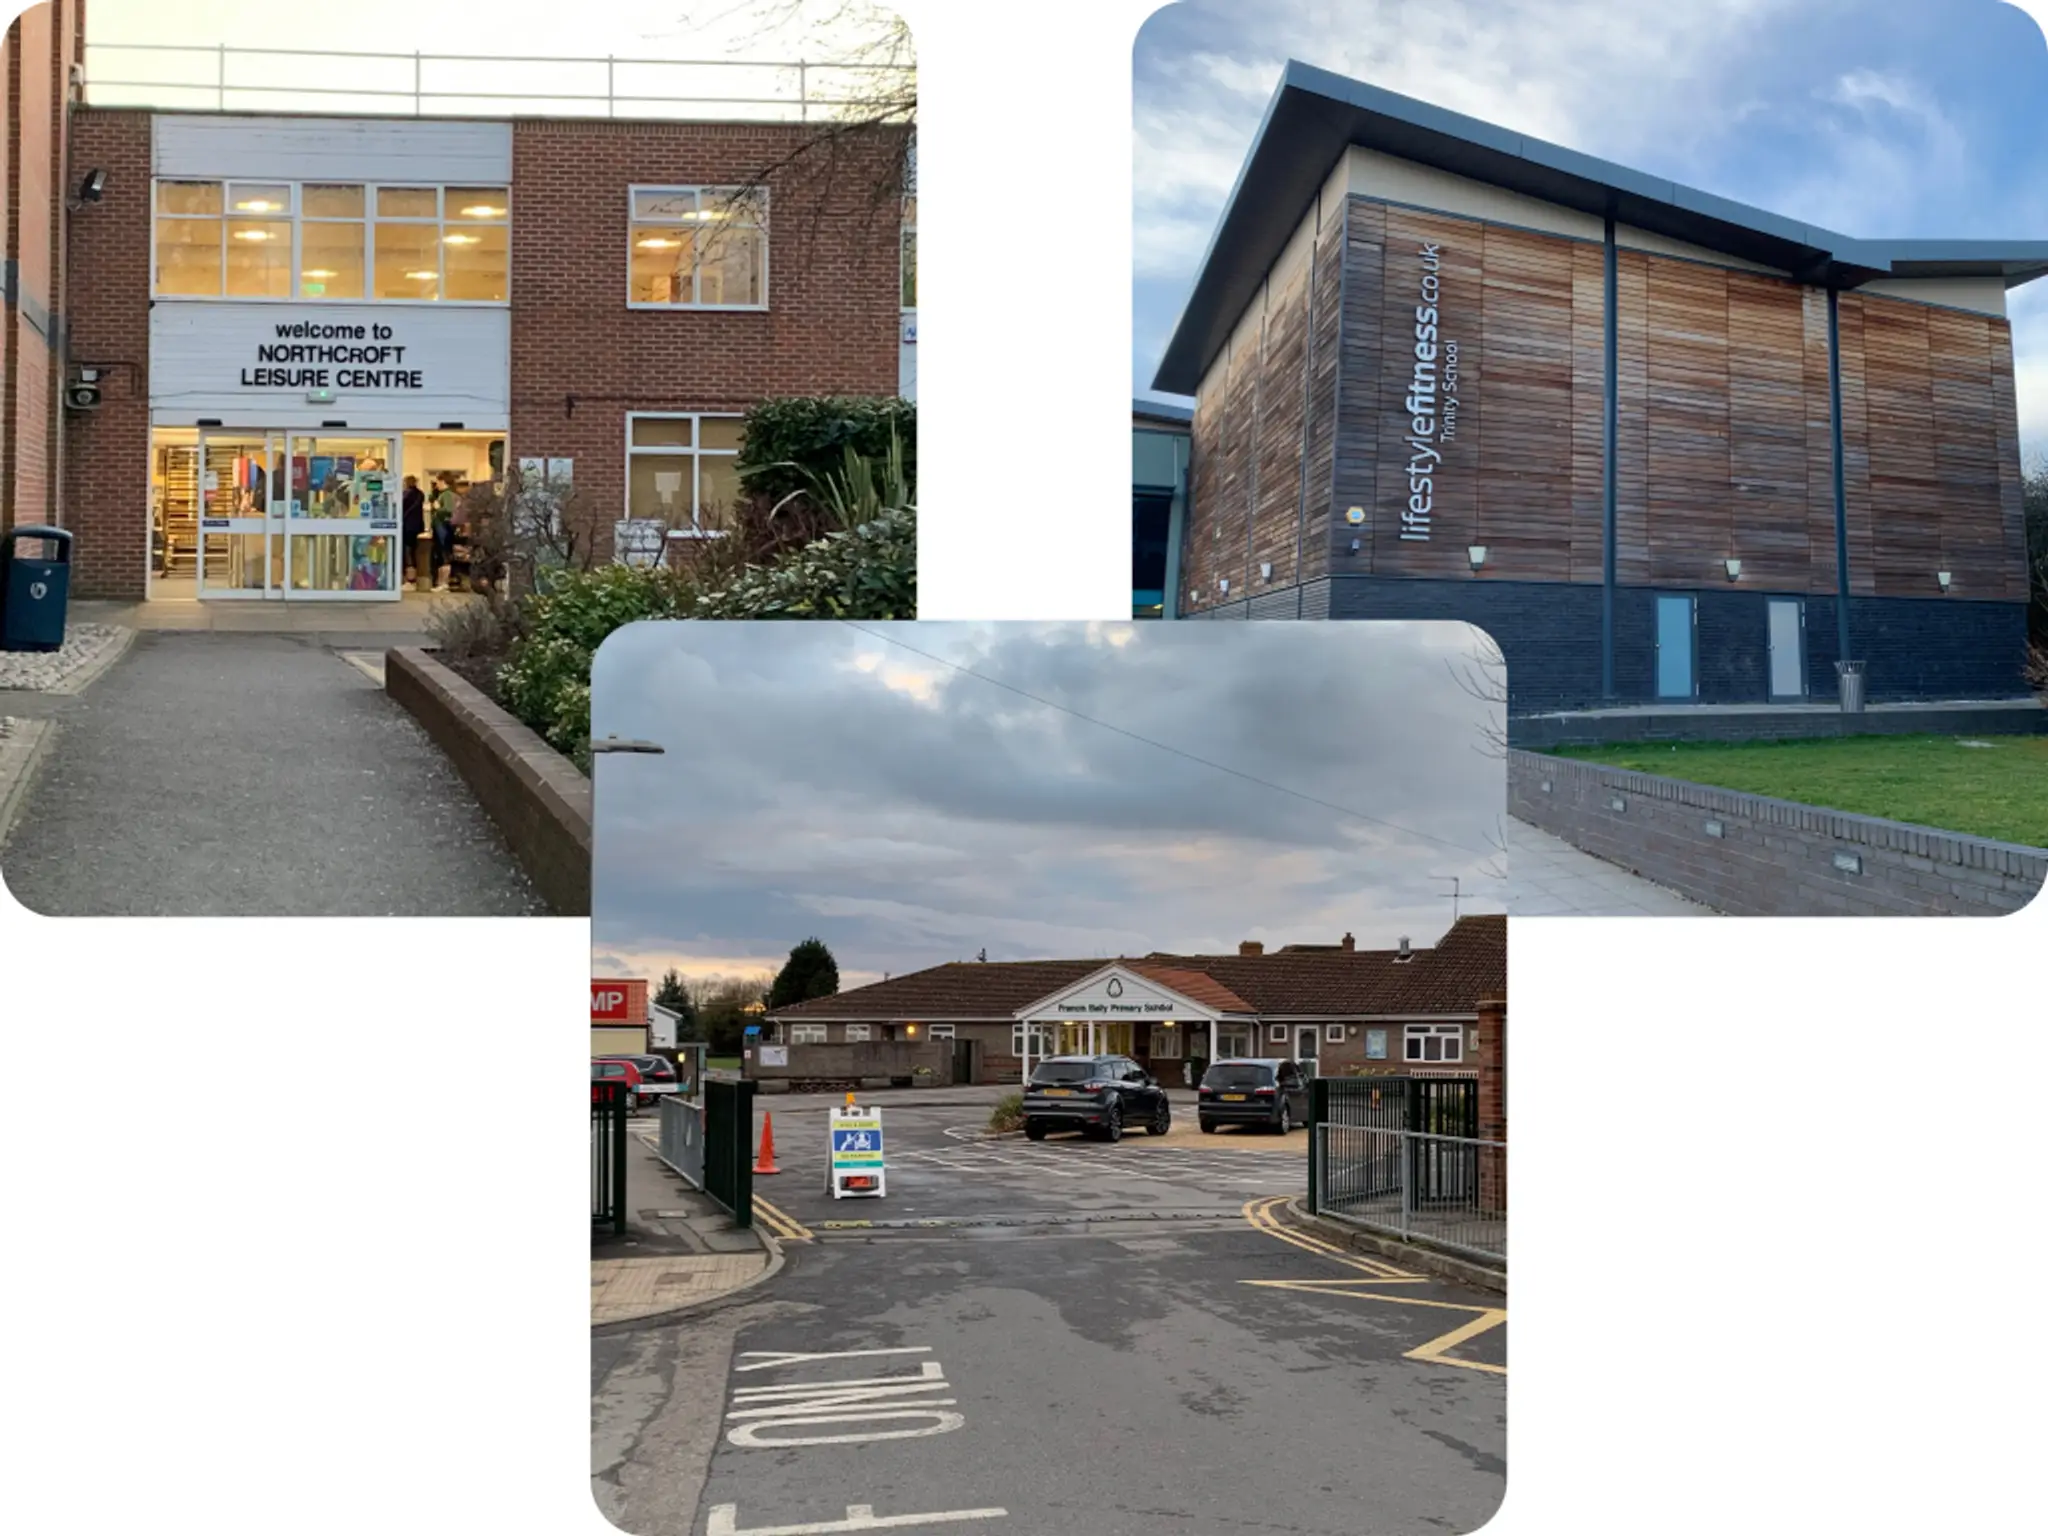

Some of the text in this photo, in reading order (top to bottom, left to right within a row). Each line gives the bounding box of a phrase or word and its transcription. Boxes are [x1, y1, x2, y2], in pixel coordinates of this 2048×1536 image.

[276, 321, 392, 340] welcome to
[258, 344, 406, 363] NORTHCROFT
[241, 369, 423, 388] LEISURE CENTRE
[1400, 242, 1442, 541] lifestylefitness.co.uk
[1440, 340, 1460, 443] Trinity School
[1111, 1003, 1142, 1013] Primary
[1145, 1003, 1173, 1012] School
[726, 1346, 966, 1446] ONLY
